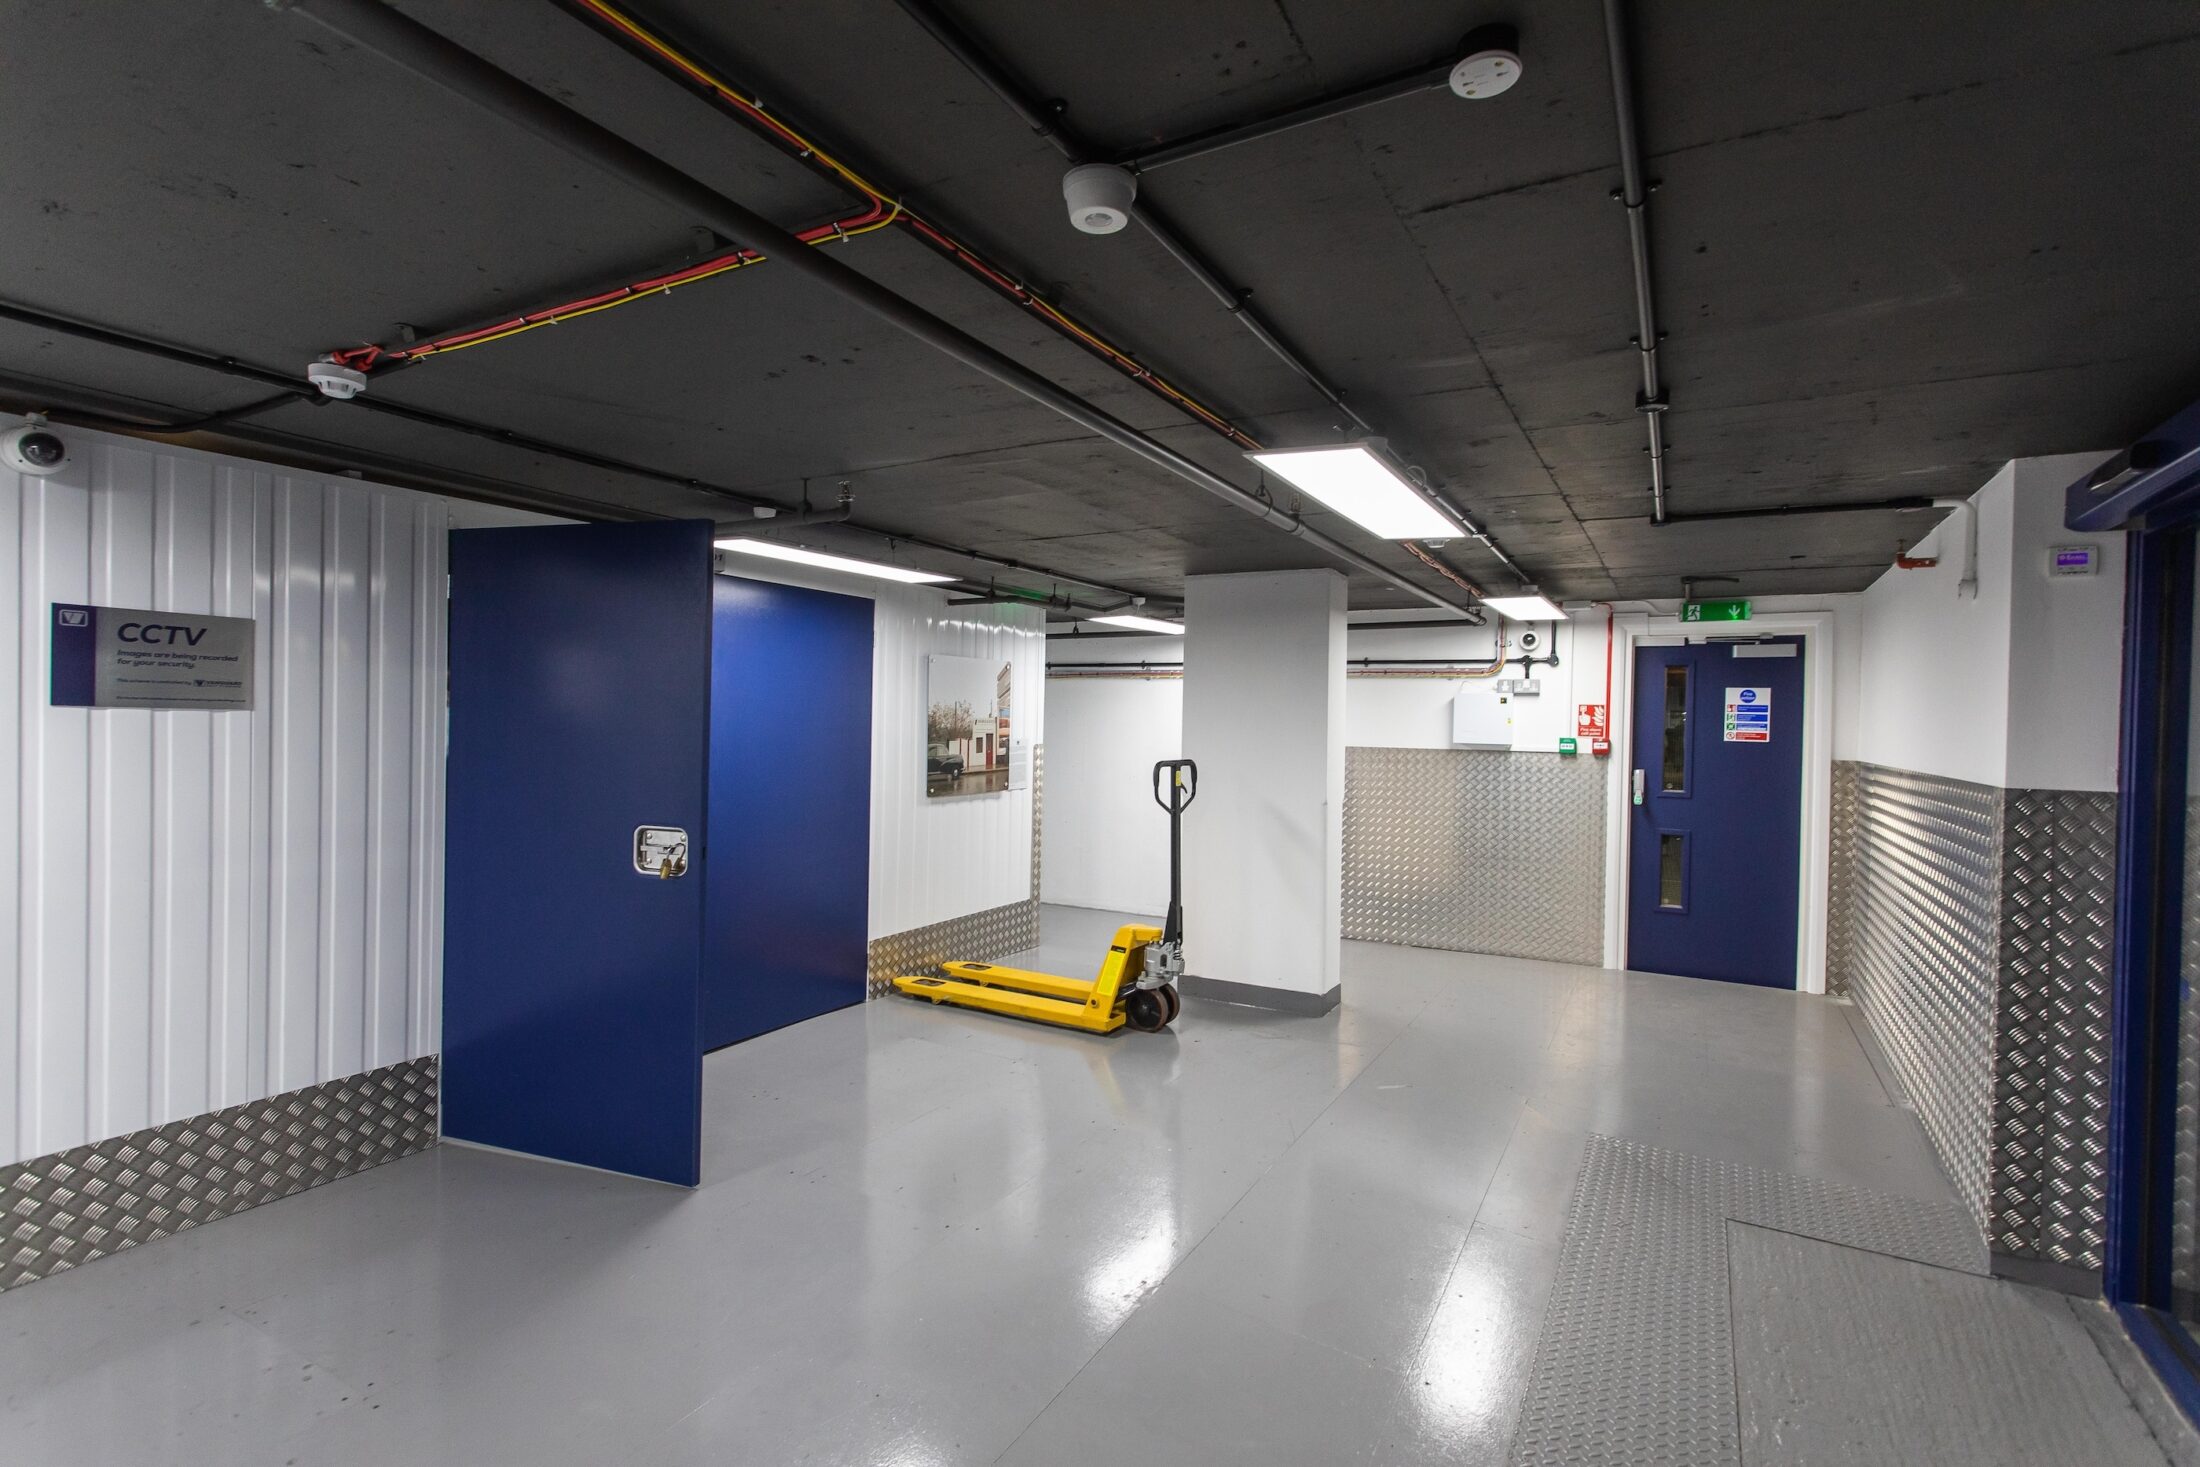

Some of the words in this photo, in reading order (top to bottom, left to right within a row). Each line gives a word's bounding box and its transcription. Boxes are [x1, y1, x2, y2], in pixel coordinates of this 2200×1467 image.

[118, 622, 207, 646] CCTV
[117, 649, 152, 659] Images
[172, 652, 198, 661] being
[198, 654, 239, 662] recorded
[117, 657, 131, 665] for
[133, 659, 156, 667] your
